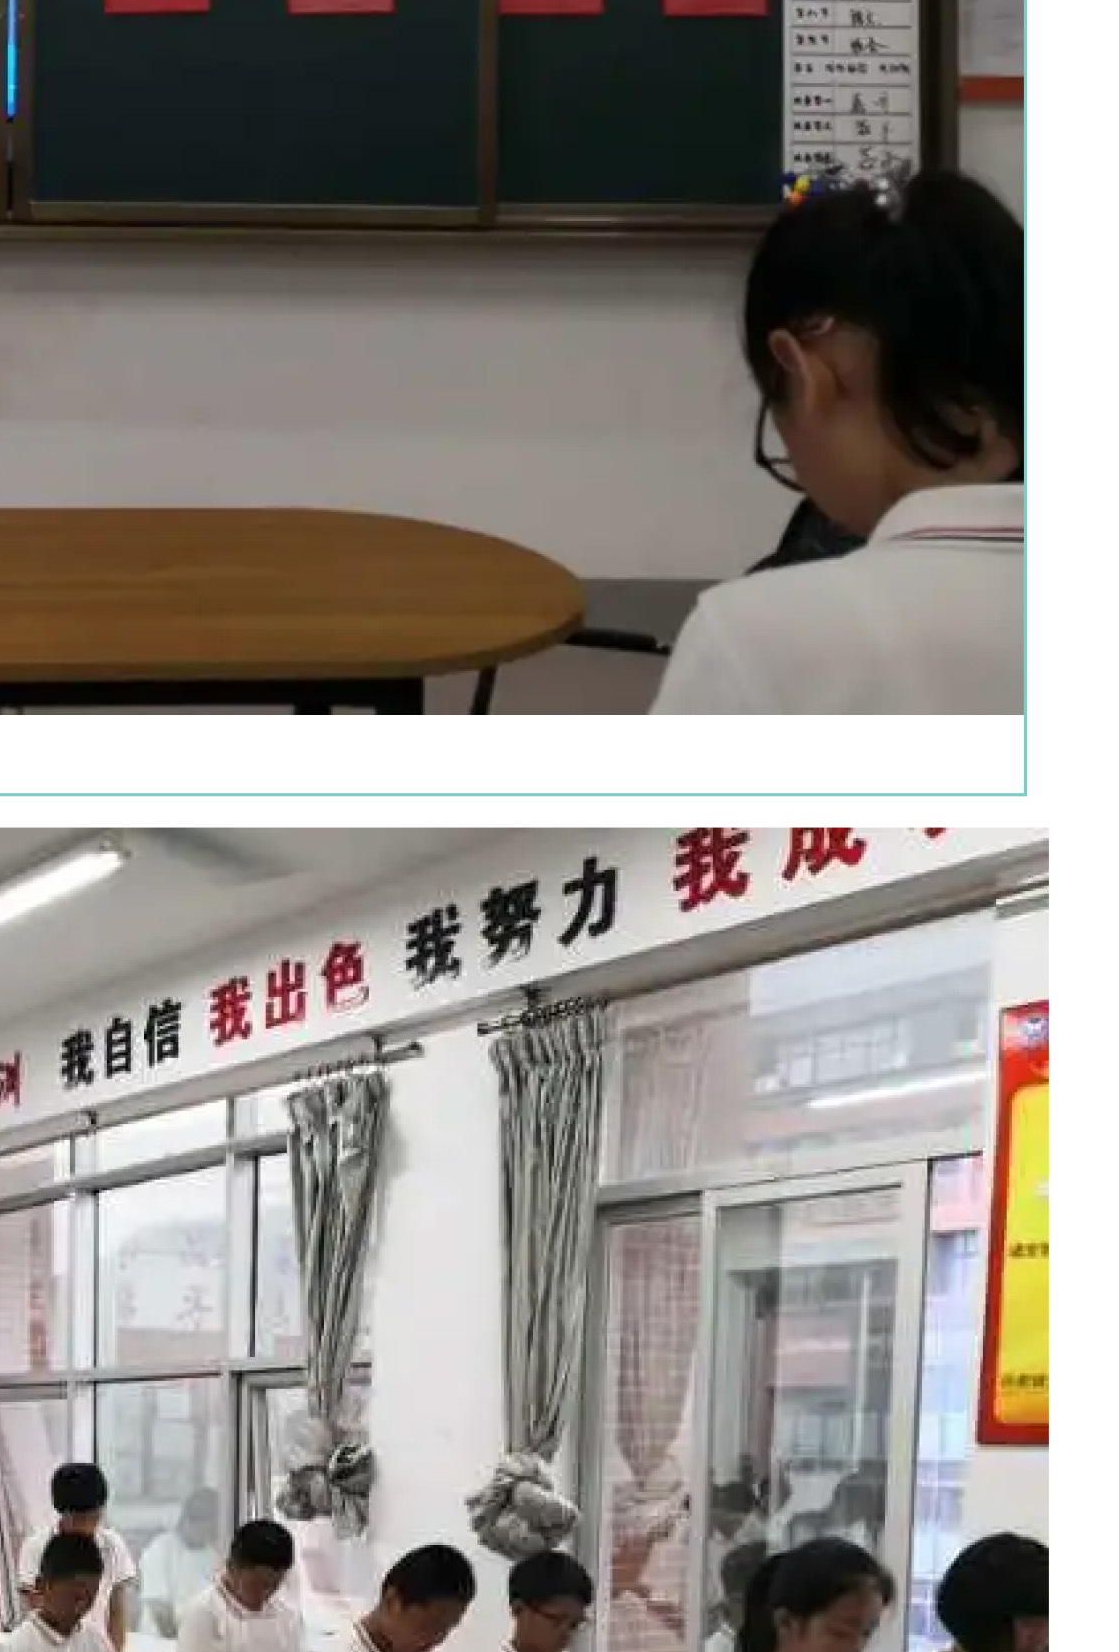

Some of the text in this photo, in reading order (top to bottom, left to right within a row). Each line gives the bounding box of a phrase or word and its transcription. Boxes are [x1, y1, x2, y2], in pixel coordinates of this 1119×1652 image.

[61, 998, 183, 1089] 我自信
[209, 941, 370, 1046] 我出色
[405, 856, 618, 990] 我努力
